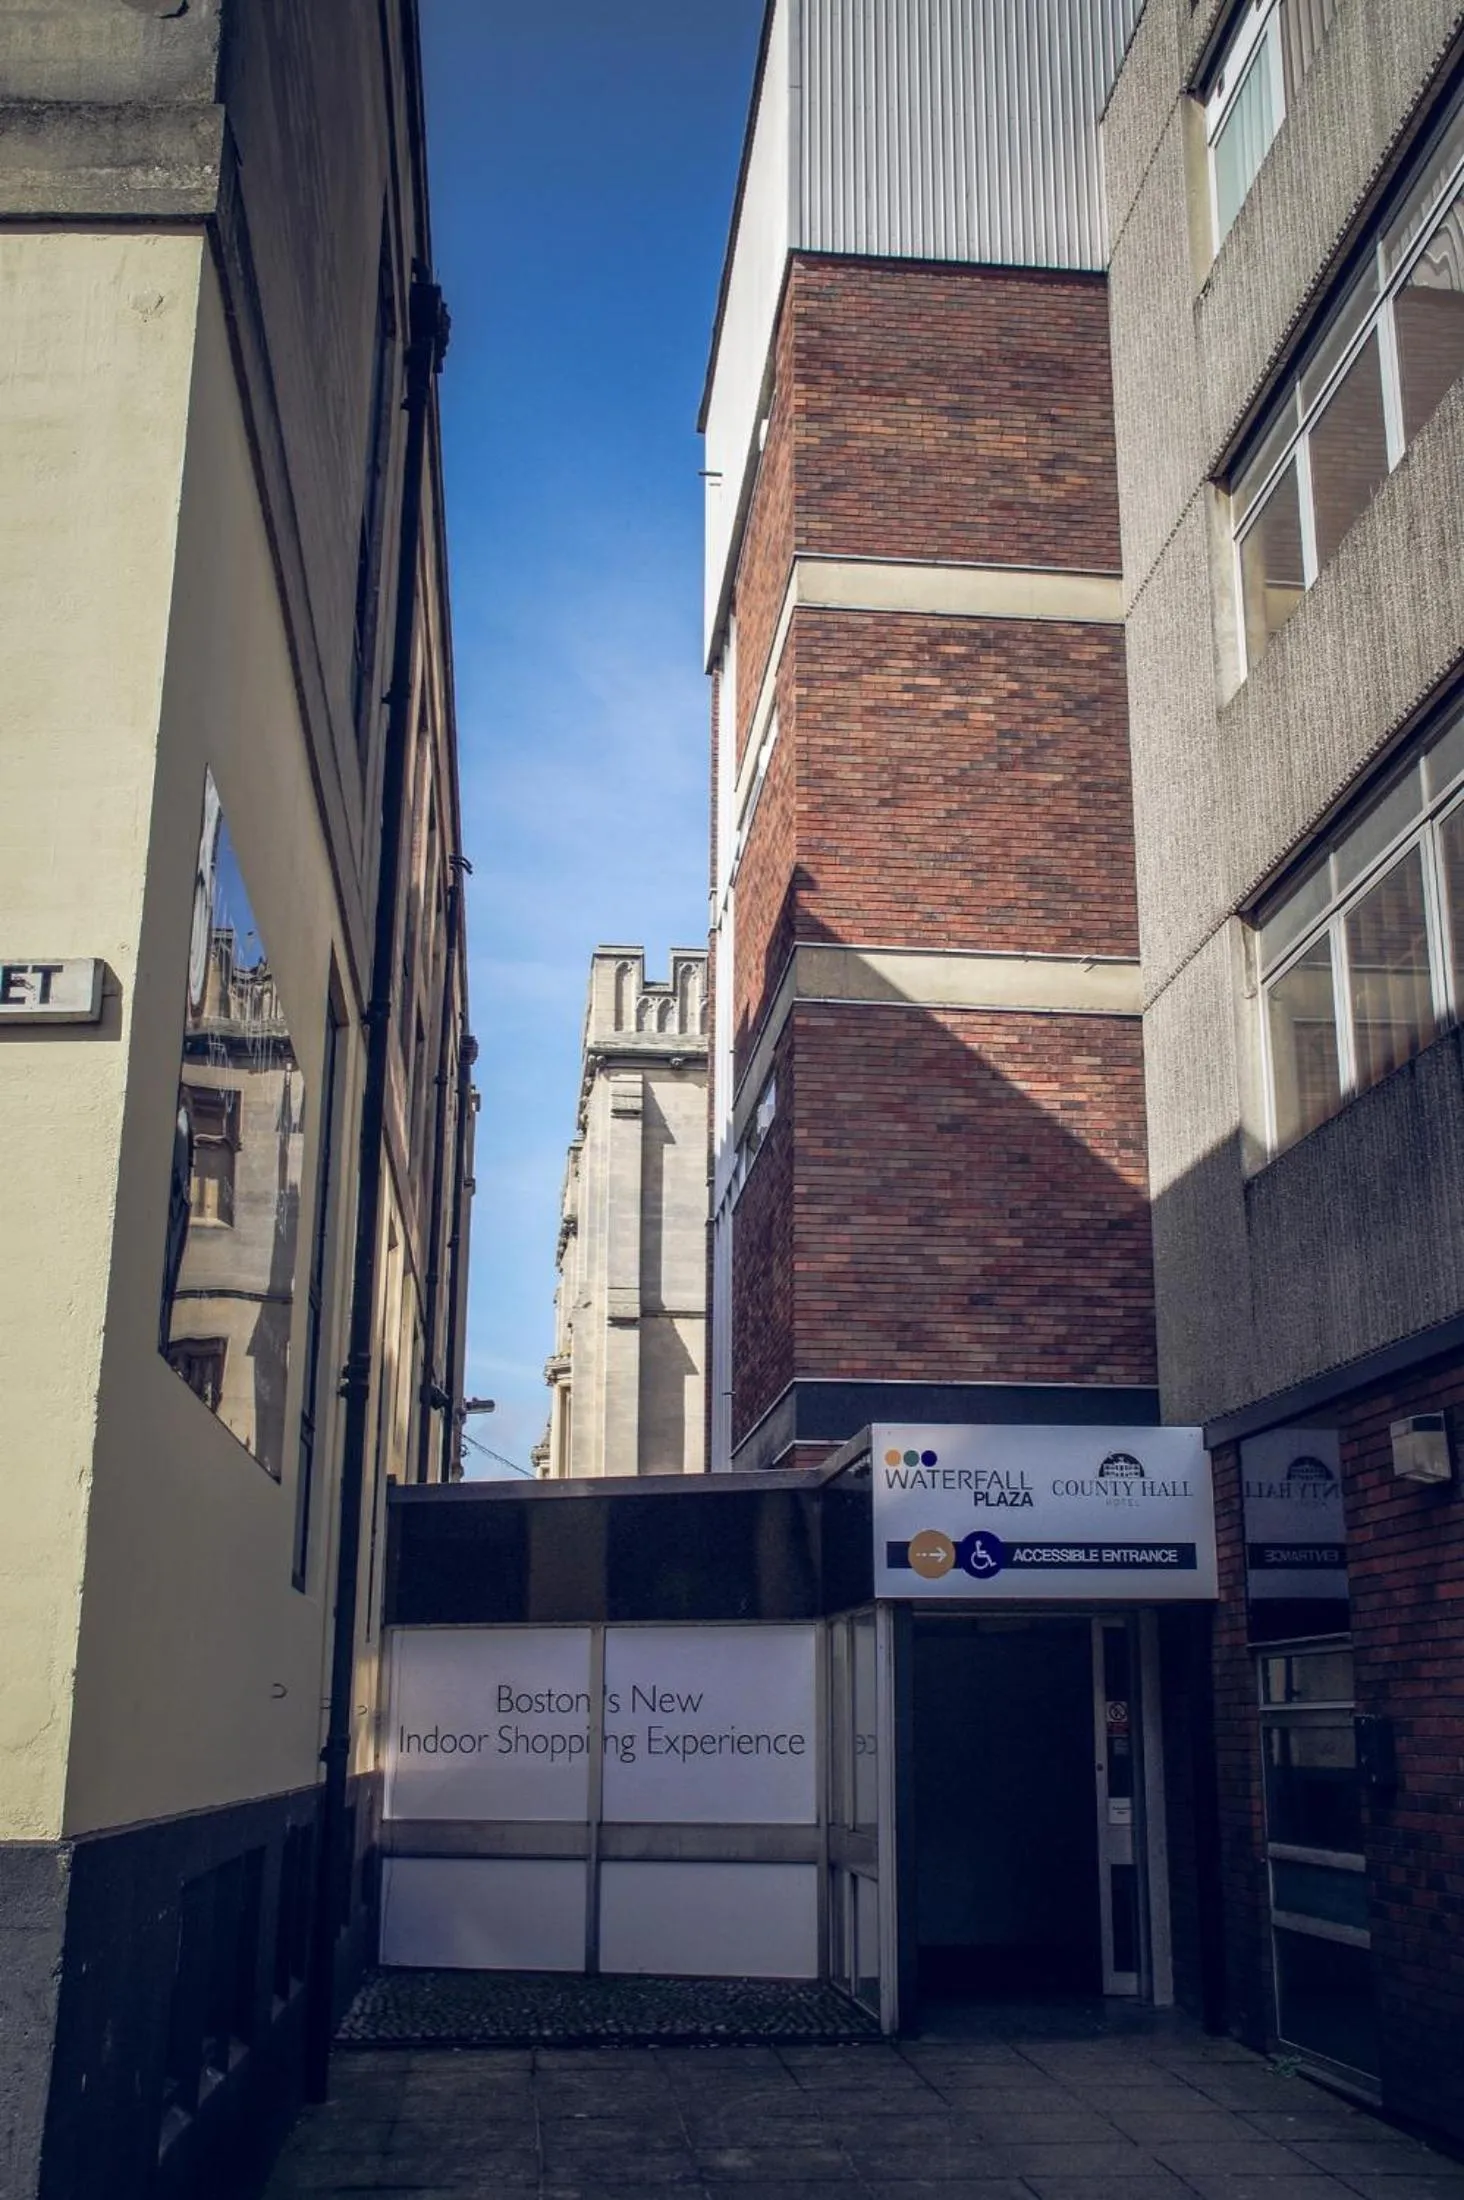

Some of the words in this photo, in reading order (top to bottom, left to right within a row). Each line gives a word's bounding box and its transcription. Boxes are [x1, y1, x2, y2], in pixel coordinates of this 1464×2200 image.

[885, 1469, 1033, 1490] WATERFALL
[1052, 1479, 1134, 1497] COUNTY
[1141, 1479, 1194, 1497] HALL
[973, 1491, 1034, 1507] PLAZA
[1012, 1549, 1099, 1563] ACCESSIBLE
[1102, 1549, 1179, 1563] ENTRANCE
[631, 1684, 704, 1713] New
[399, 1724, 488, 1756] Indoor
[497, 1725, 636, 1763] Shopping
[647, 1725, 806, 1763] Experience
